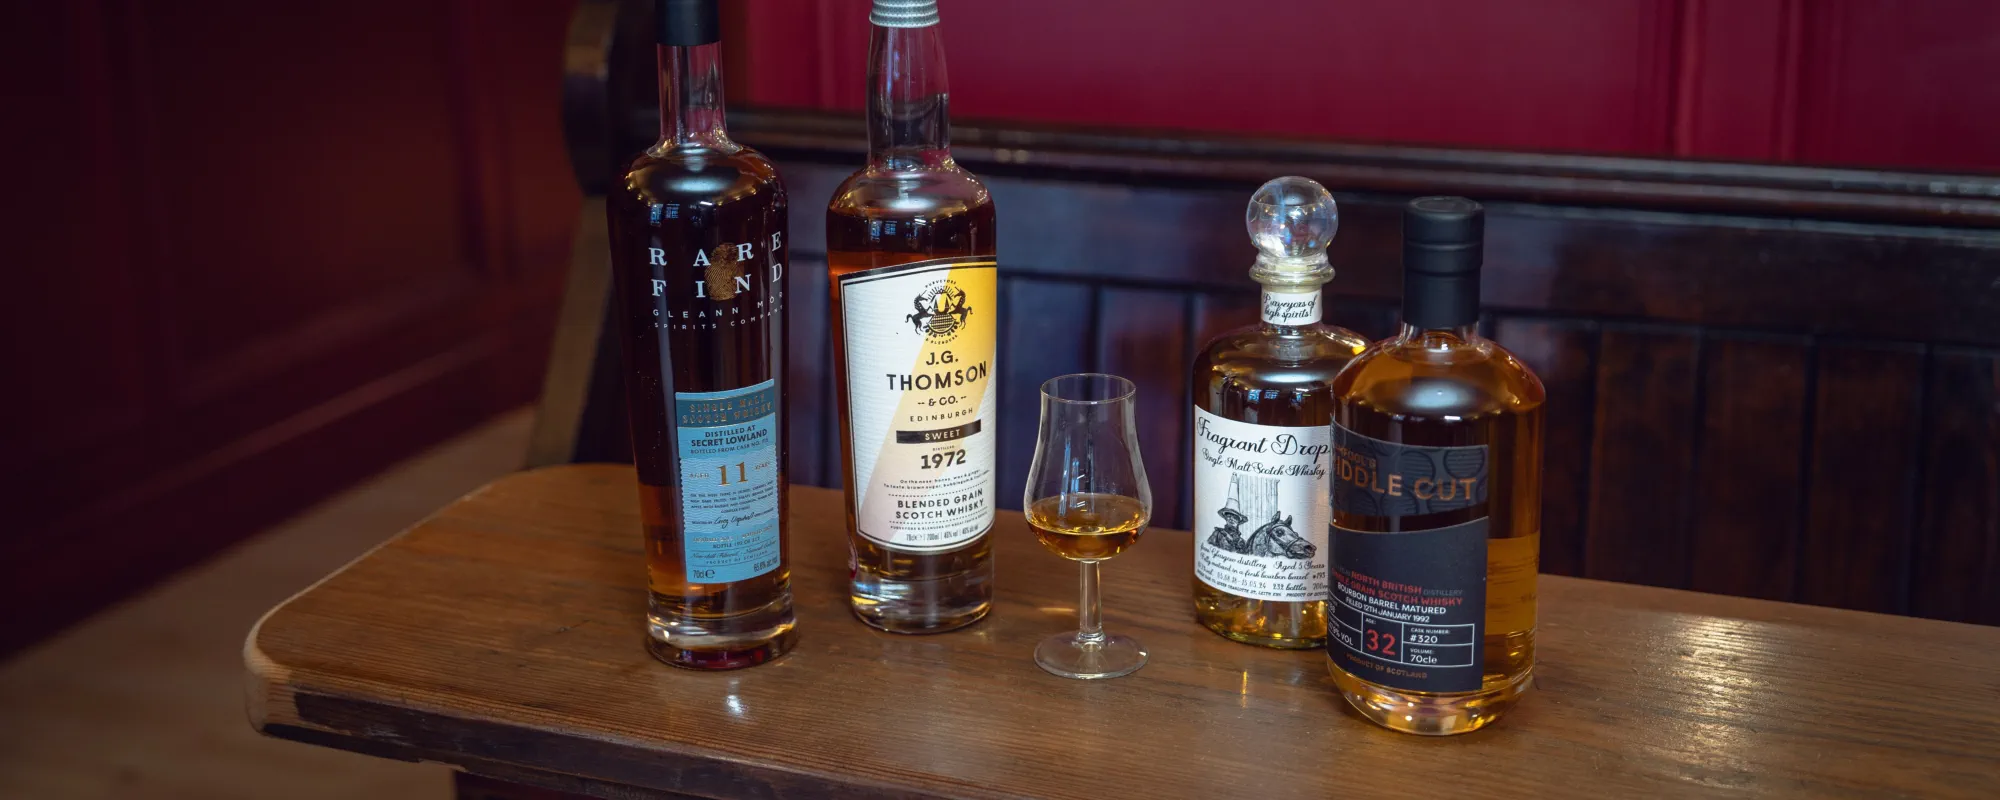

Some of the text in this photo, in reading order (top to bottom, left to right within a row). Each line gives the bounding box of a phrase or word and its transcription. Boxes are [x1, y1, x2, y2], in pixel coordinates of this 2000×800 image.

[648, 231, 781, 266] RARE
[651, 263, 783, 298] FIND
[1307, 294, 1317, 309] of
[652, 307, 739, 319] GLEANN
[1264, 305, 1313, 322] high spirits!
[654, 322, 717, 330] SPIRITS
[926, 350, 959, 366] J.G.
[886, 360, 987, 391] THOMSON
[689, 402, 733, 413] SINGLE
[928, 395, 958, 407] & CO.
[682, 402, 772, 424] SCOTCH WHISKY
[909, 407, 973, 422] EDINBURGH
[691, 439, 723, 448] SECRET
[726, 429, 768, 445] LOWLAND
[705, 427, 745, 438] DISTILLED
[924, 429, 961, 441] SWEET
[1196, 416, 1268, 454] Fragrant
[920, 449, 966, 470] 1972
[1224, 455, 1251, 472] Malt
[1251, 461, 1284, 476] Scotch
[1285, 463, 1325, 480] Whisky
[1335, 455, 1402, 497] IDDLE
[1414, 477, 1477, 500] CUT
[897, 487, 983, 509] BLENDED GRAIN
[895, 497, 985, 520] SCOTCH WHISKY
[1237, 556, 1267, 571] distillery
[1273, 560, 1297, 572] Aged
[1304, 560, 1325, 570] Years
[1260, 571, 1287, 580] bourbon
[1351, 570, 1463, 597] NORTH BRITISH DISTILLERY
[1285, 582, 1307, 591] bottles
[1312, 582, 1329, 590] 700m
[1351, 580, 1375, 596] GRAIN
[1378, 589, 1419, 604] SCOTCH
[1421, 597, 1463, 606] WHISKY
[1337, 582, 1367, 602] BOURBON
[1368, 596, 1400, 611] BARREL
[1401, 603, 1446, 615] MATURED
[1345, 597, 1363, 610] FILLED
[1363, 603, 1378, 614] 12TH
[1378, 608, 1412, 621] JANUARY
[1412, 614, 1430, 623] 1992
[1365, 617, 1377, 625] AGE:
[1340, 630, 1354, 646] VOL
[1366, 629, 1396, 656] 32
[1410, 634, 1438, 644] #320
[1375, 663, 1385, 672] OF
[1386, 666, 1428, 679] SCOTLAND
